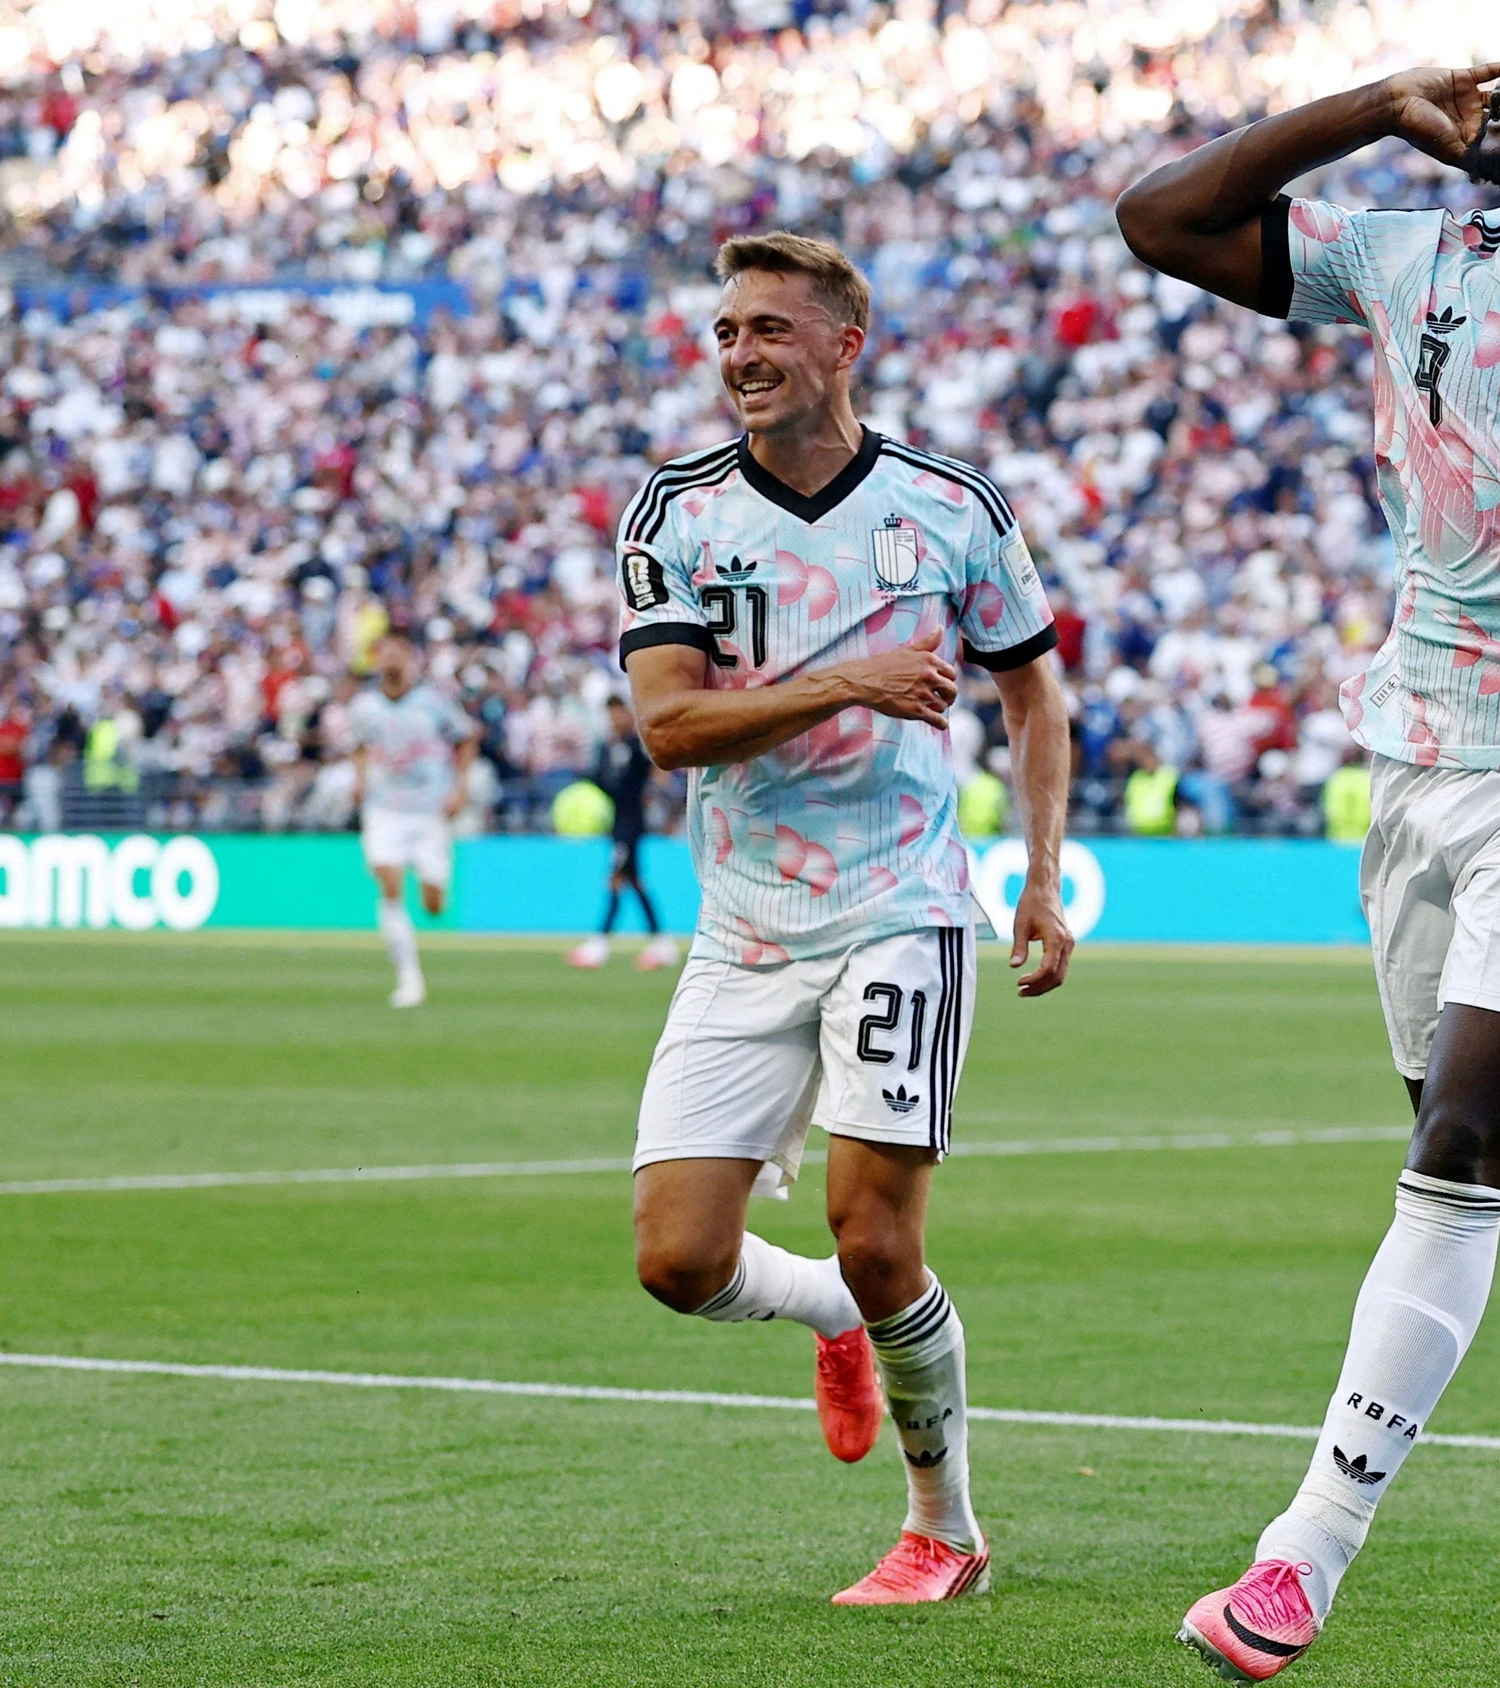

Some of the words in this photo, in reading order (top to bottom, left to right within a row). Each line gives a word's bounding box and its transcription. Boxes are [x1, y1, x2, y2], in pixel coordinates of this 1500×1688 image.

[1414, 333, 1451, 430] 9
[702, 586, 768, 670] 21
[857, 981, 927, 1073] 21
[1347, 1392, 1418, 1440] RBFA
